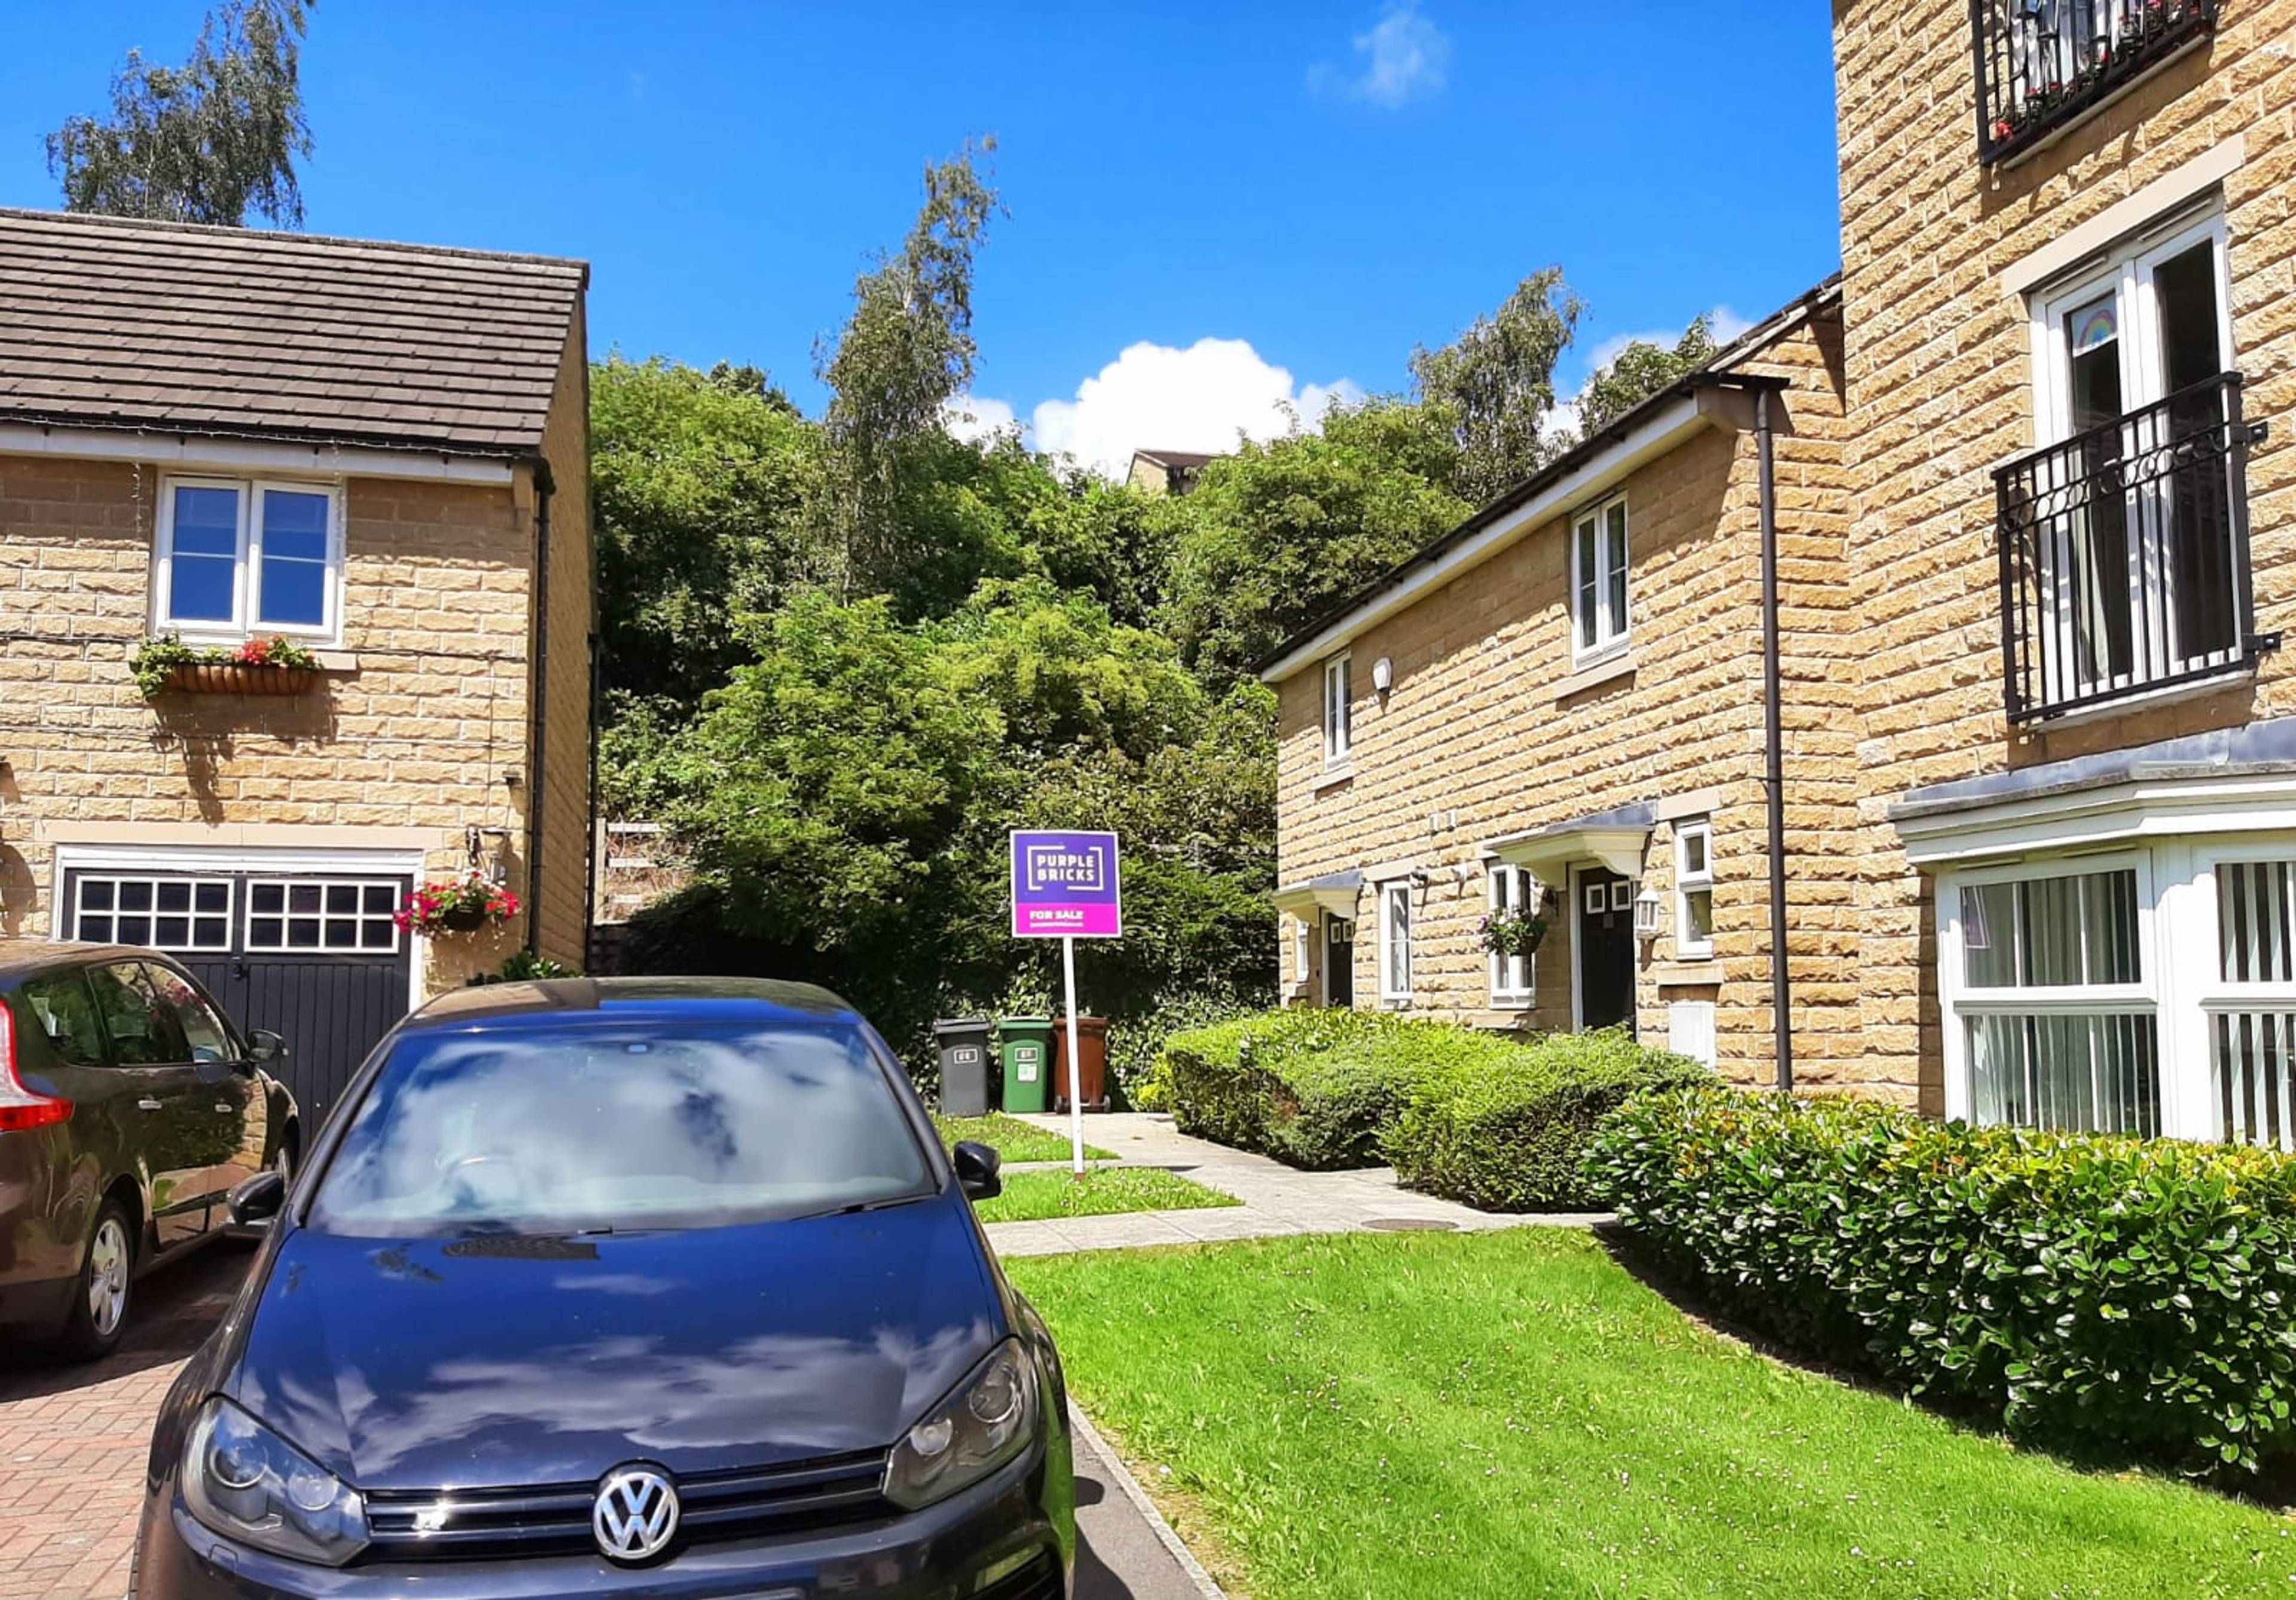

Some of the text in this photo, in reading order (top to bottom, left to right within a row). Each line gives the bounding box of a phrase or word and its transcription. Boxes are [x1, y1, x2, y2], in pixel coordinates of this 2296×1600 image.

[1037, 854, 1094, 867] PURPLE
[1037, 869, 1094, 881] BRICKS
[1030, 911, 1083, 920] FOR SALE
